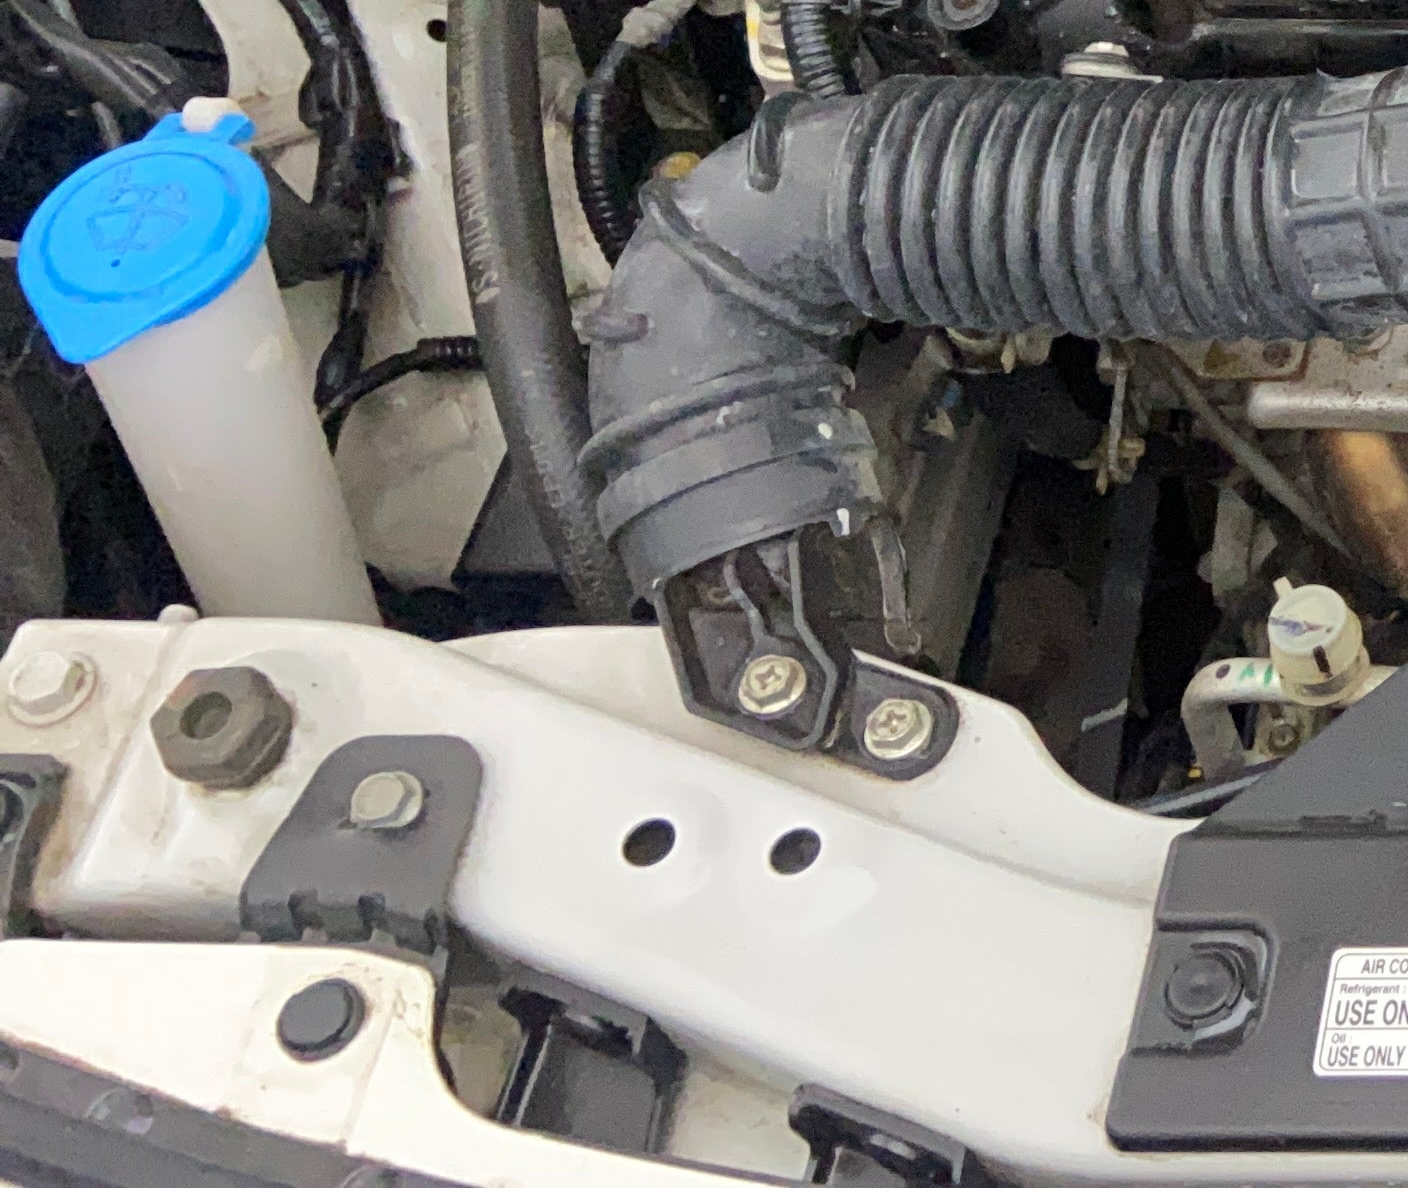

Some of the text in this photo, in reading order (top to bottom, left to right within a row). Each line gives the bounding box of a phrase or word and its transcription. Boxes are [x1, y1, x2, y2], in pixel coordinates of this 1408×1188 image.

[1361, 959, 1386, 974] AIR
[1334, 1000, 1377, 1025] USE
[1328, 1046, 1361, 1067] USE
[1364, 1046, 1406, 1066] ONLY
